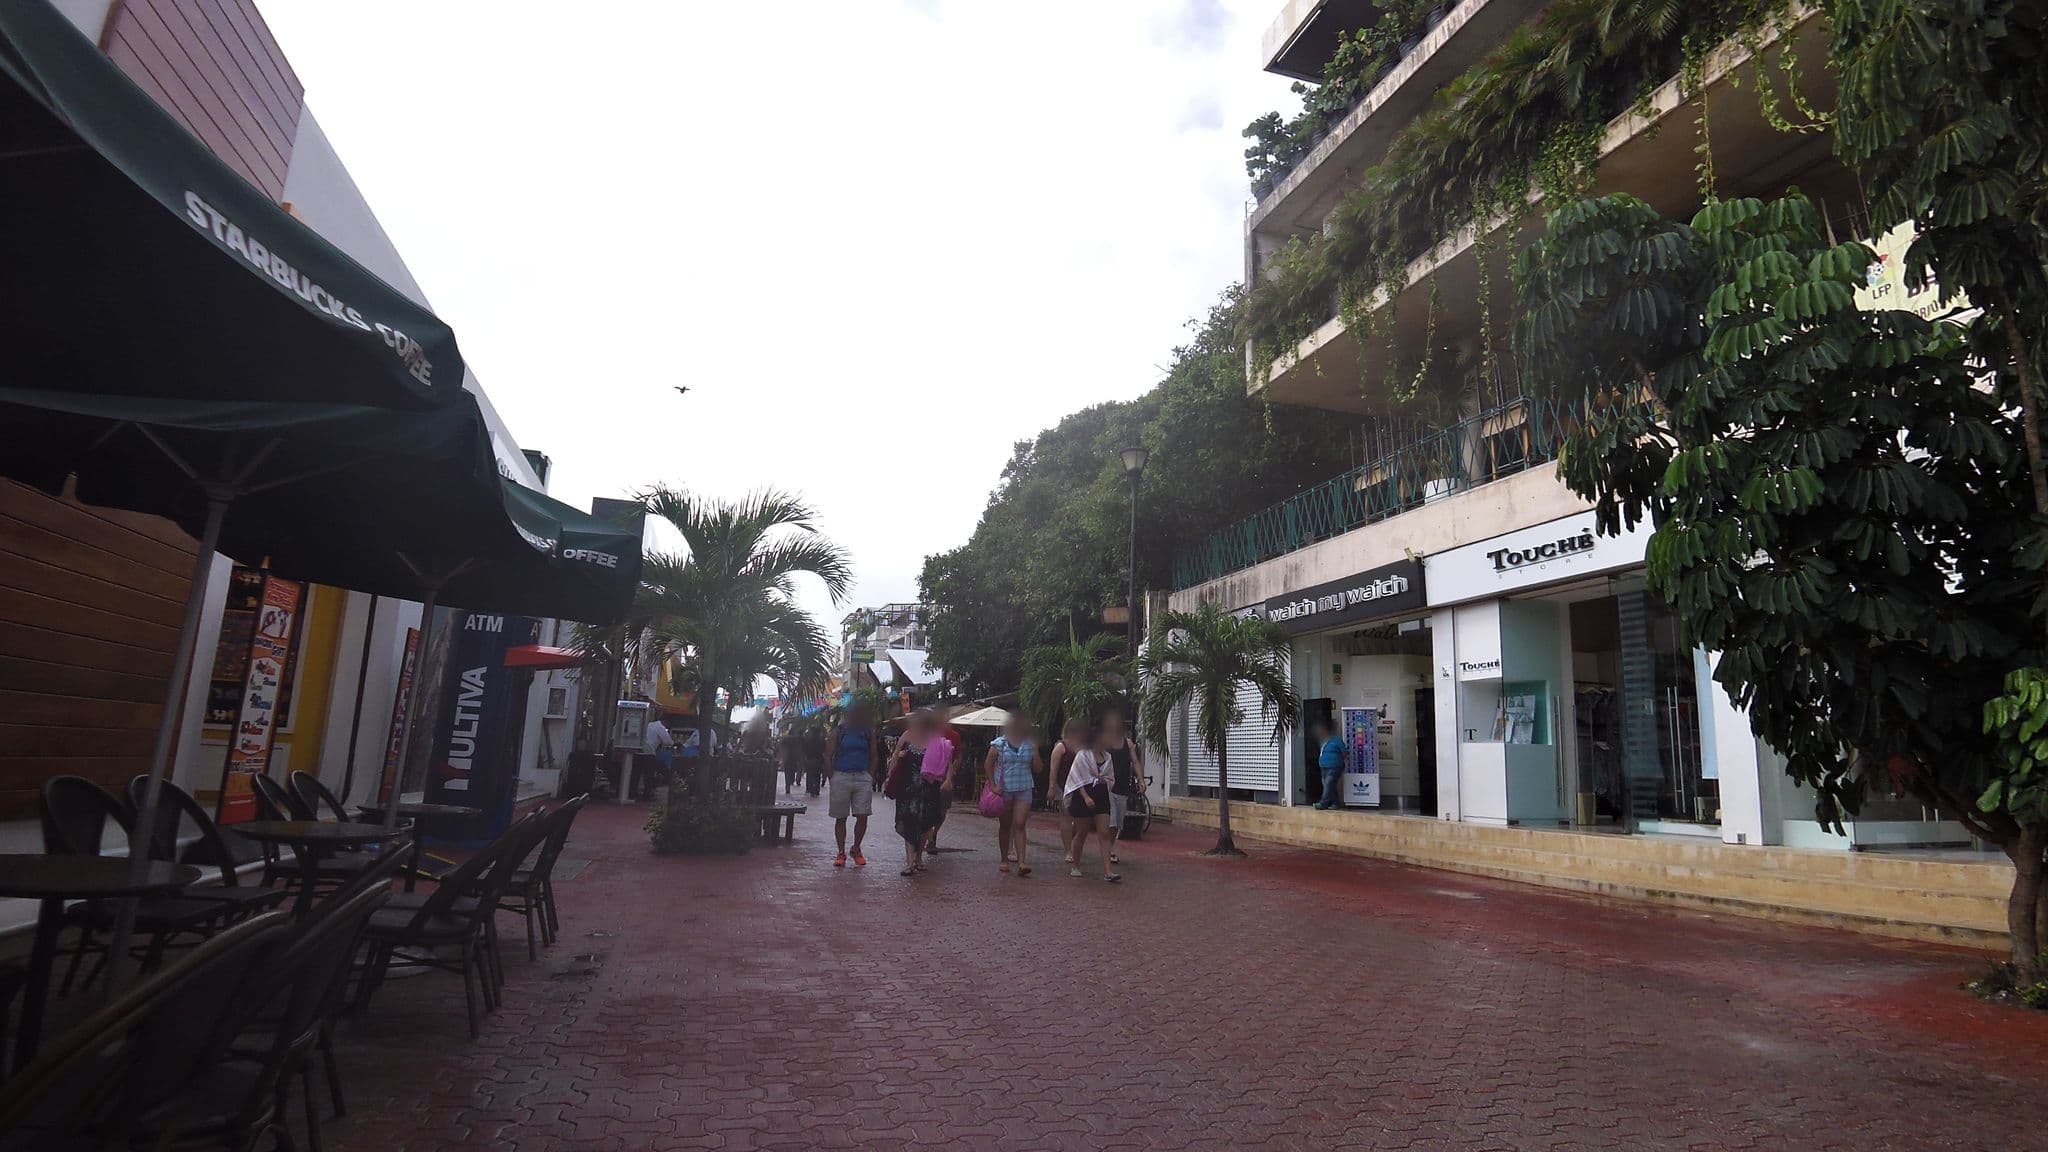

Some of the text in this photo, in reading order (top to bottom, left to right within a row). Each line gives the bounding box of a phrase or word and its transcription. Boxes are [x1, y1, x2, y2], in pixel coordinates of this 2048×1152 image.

[185, 190, 371, 331] STARBUCKS
[1872, 283, 1892, 300] LFP
[1268, 574, 1409, 622] watch my watch
[464, 614, 504, 633] ATM
[443, 666, 488, 790] MULTIVA
